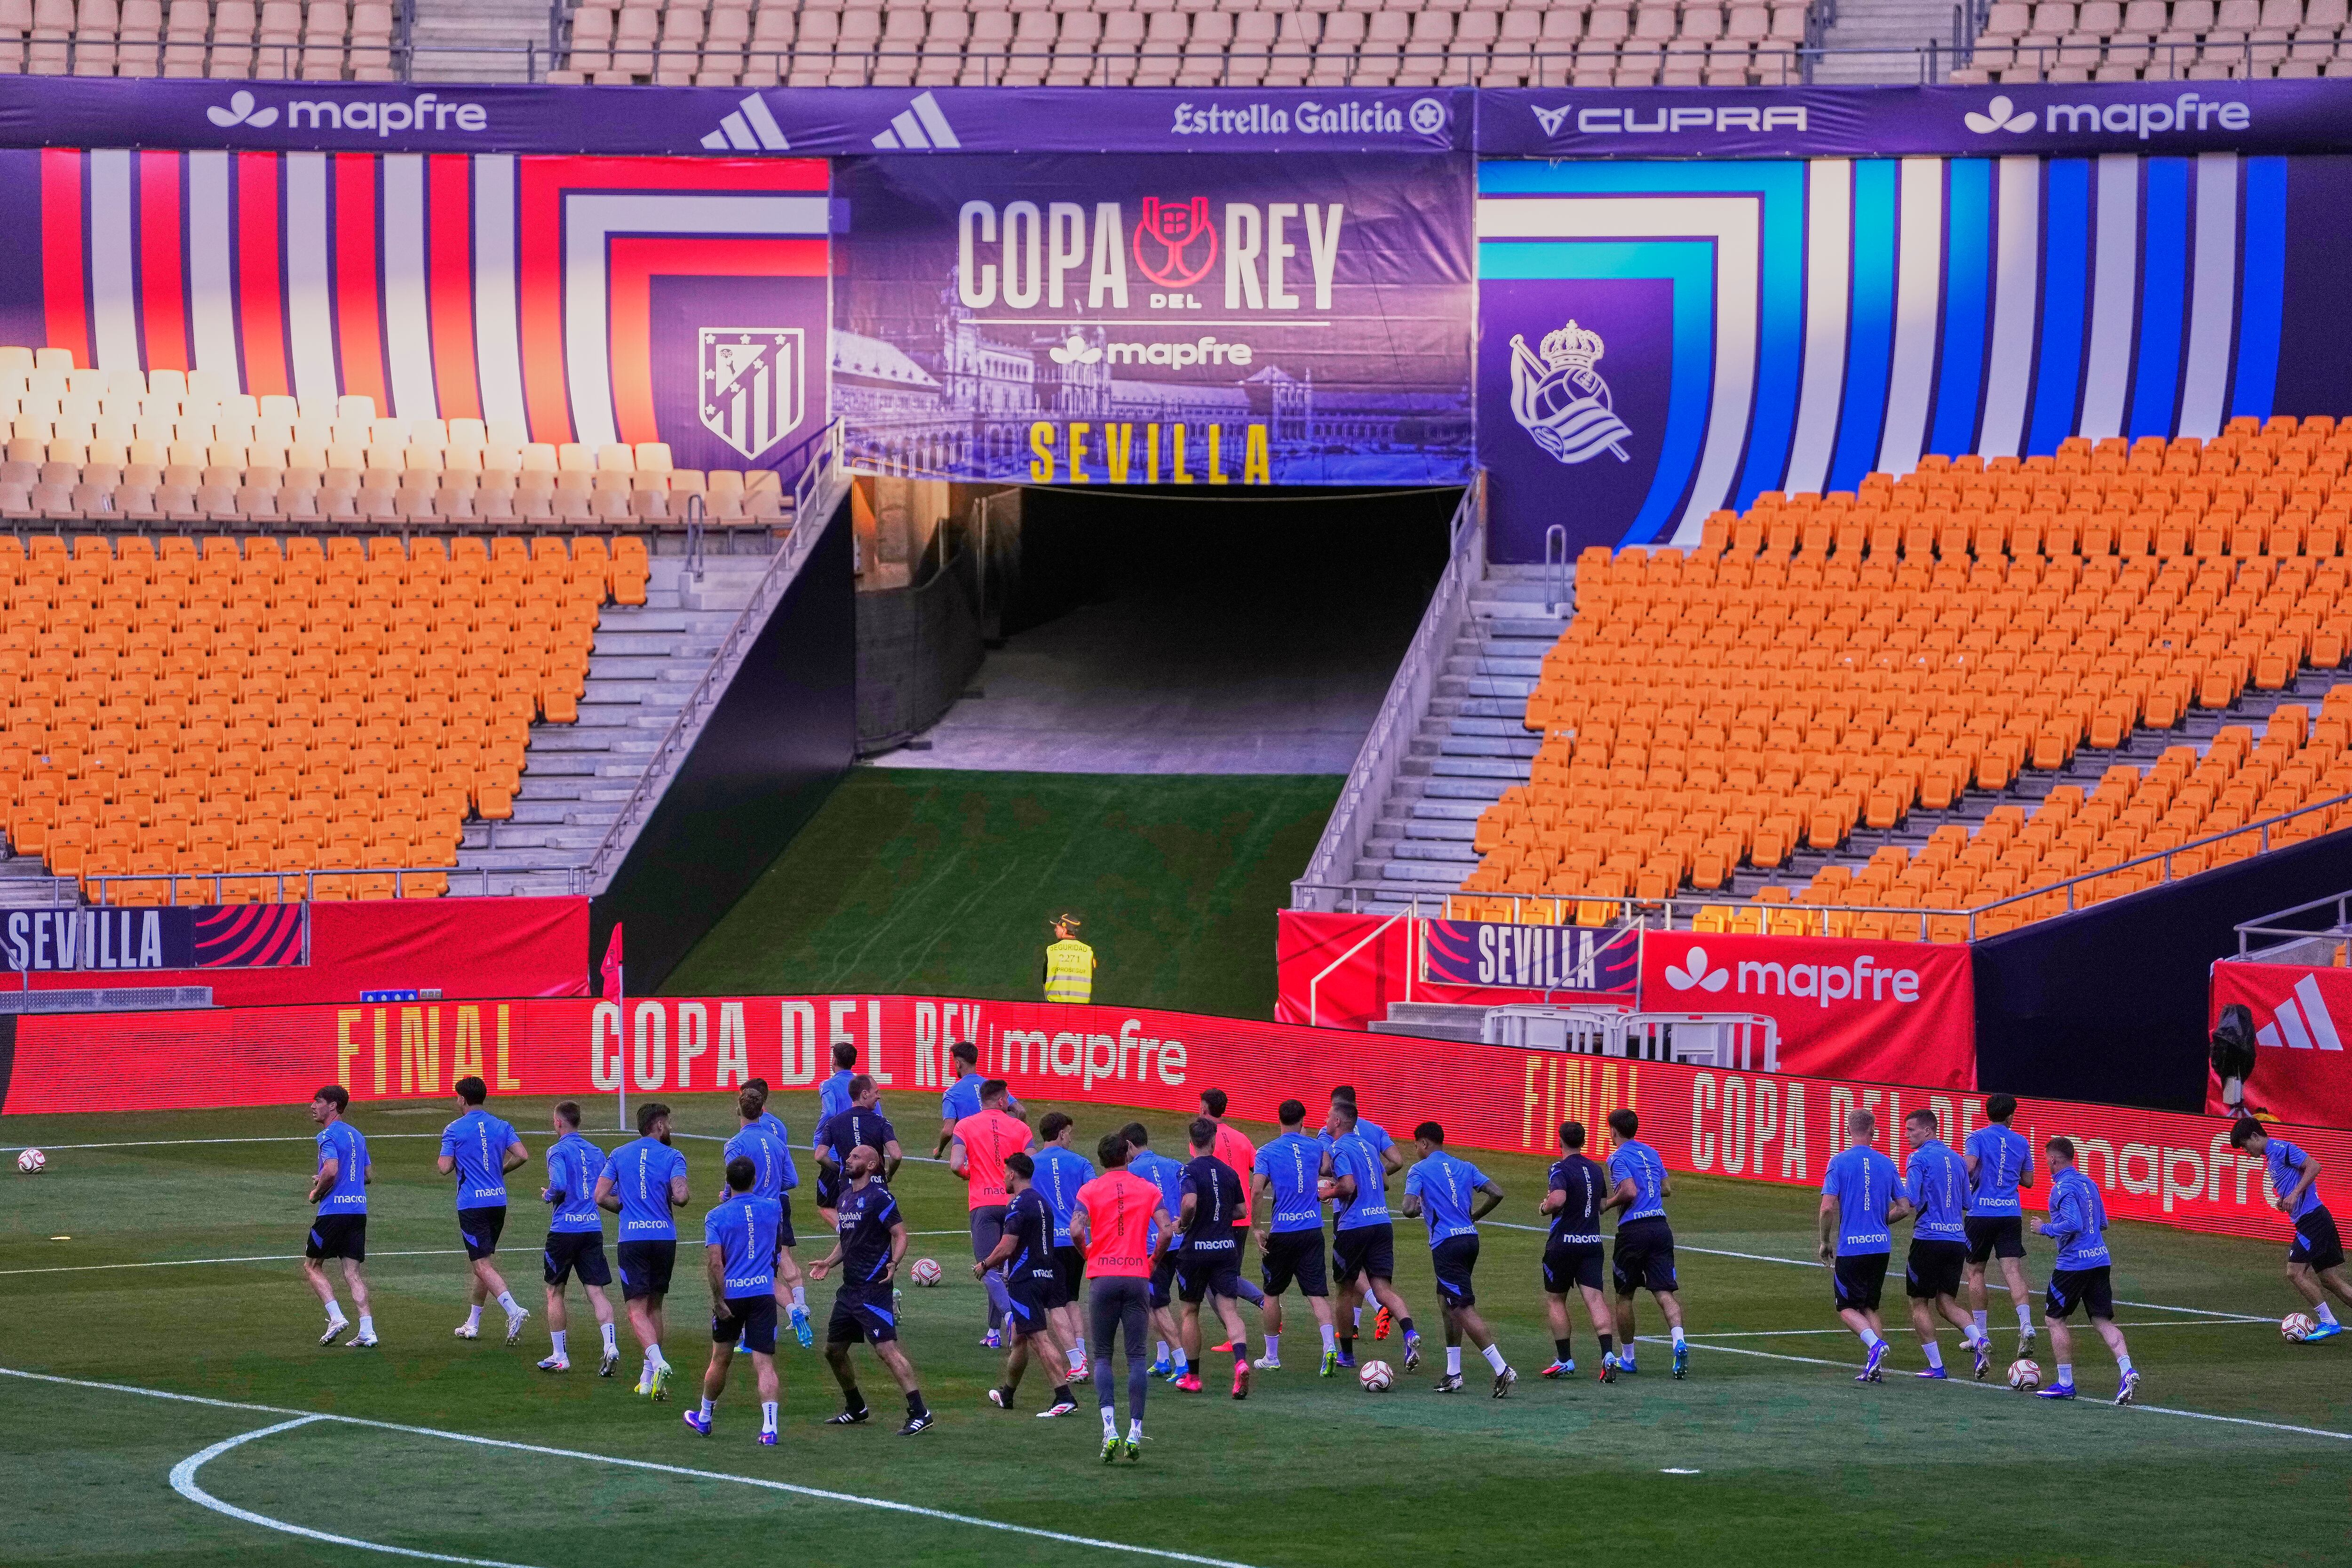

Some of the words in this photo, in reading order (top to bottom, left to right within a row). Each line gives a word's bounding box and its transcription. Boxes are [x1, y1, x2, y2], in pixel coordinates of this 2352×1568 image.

[287, 93, 487, 137] mapfre
[1171, 102, 1290, 135] Estrella
[1295, 100, 1404, 134] Galicia
[1577, 105, 1807, 134] CUPRA
[2046, 91, 2251, 139] mapfre
[958, 201, 1129, 309] COPA
[1150, 294, 1202, 309] DEL
[1224, 203, 1344, 310] REY
[1107, 336, 1252, 371] mapfre
[1030, 421, 1270, 485] SEVILLA
[8, 910, 161, 971] SEVILLA
[1050, 944, 1087, 952] SEGURIDAD
[1478, 925, 1596, 988] SEVILLA
[1738, 955, 1920, 1008] mapfre
[337, 1004, 520, 1095] FINAL
[591, 1001, 749, 1091] COPA
[781, 1000, 893, 1085] DEL
[1003, 1019, 1187, 1091] mapfre
[1691, 1071, 1807, 1179] COPA
[761, 1138, 770, 1154] REAL
[1222, 1132, 1230, 1147] REAL
[1292, 1143, 1301, 1159] REAL
[1358, 1142, 1369, 1157] REAL
[1638, 1150, 1648, 1165] REAL
[1443, 1163, 1452, 1177] REAL
[1582, 1167, 1591, 1183] REAL
[475, 1186, 505, 1197] macron
[1979, 1197, 2018, 1206] macron
[1278, 1210, 1316, 1221] macron
[628, 1220, 668, 1229] macron
[1931, 1222, 1964, 1232] macron
[1194, 1239, 1235, 1250] macron
[1564, 1234, 1602, 1243] macron
[1847, 1233, 1888, 1245] macron
[1098, 1256, 1143, 1266] macron
[725, 1275, 768, 1287] macron
